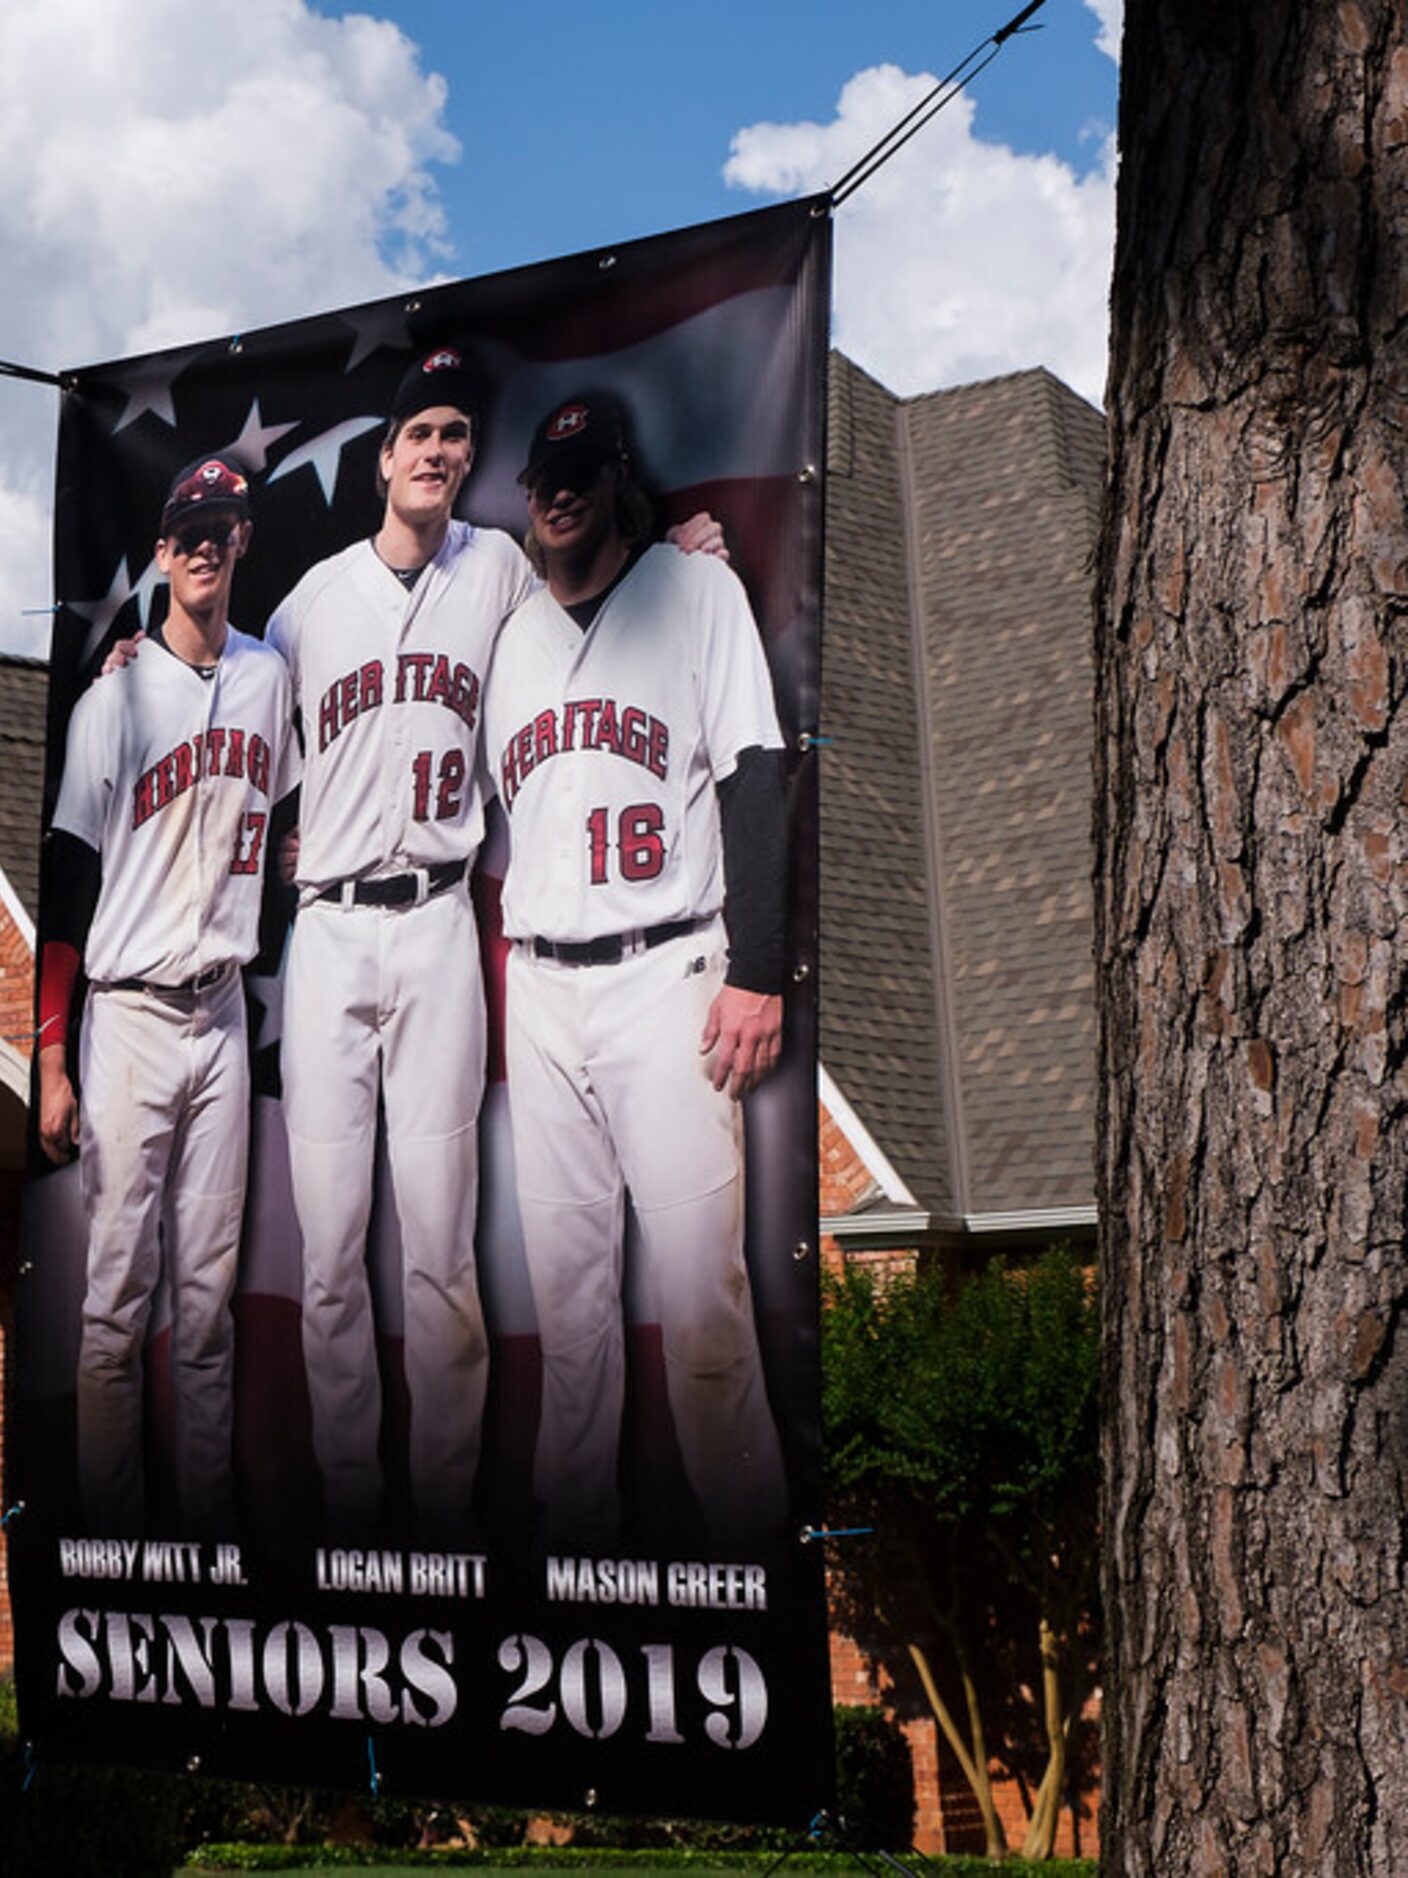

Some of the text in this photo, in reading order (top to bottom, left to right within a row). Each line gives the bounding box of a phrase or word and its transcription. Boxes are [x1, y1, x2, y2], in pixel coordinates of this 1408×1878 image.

[413, 748, 465, 824] 12
[501, 699, 669, 815] HERITAGE
[229, 813, 266, 874] 17
[587, 803, 667, 885] 16
[59, 1539, 248, 1586] BOBBY WITT JR.
[316, 1548, 487, 1598] LOGAN BRITT
[546, 1556, 768, 1611] MASON GREER
[57, 1608, 769, 1750] SENIORS 2019
